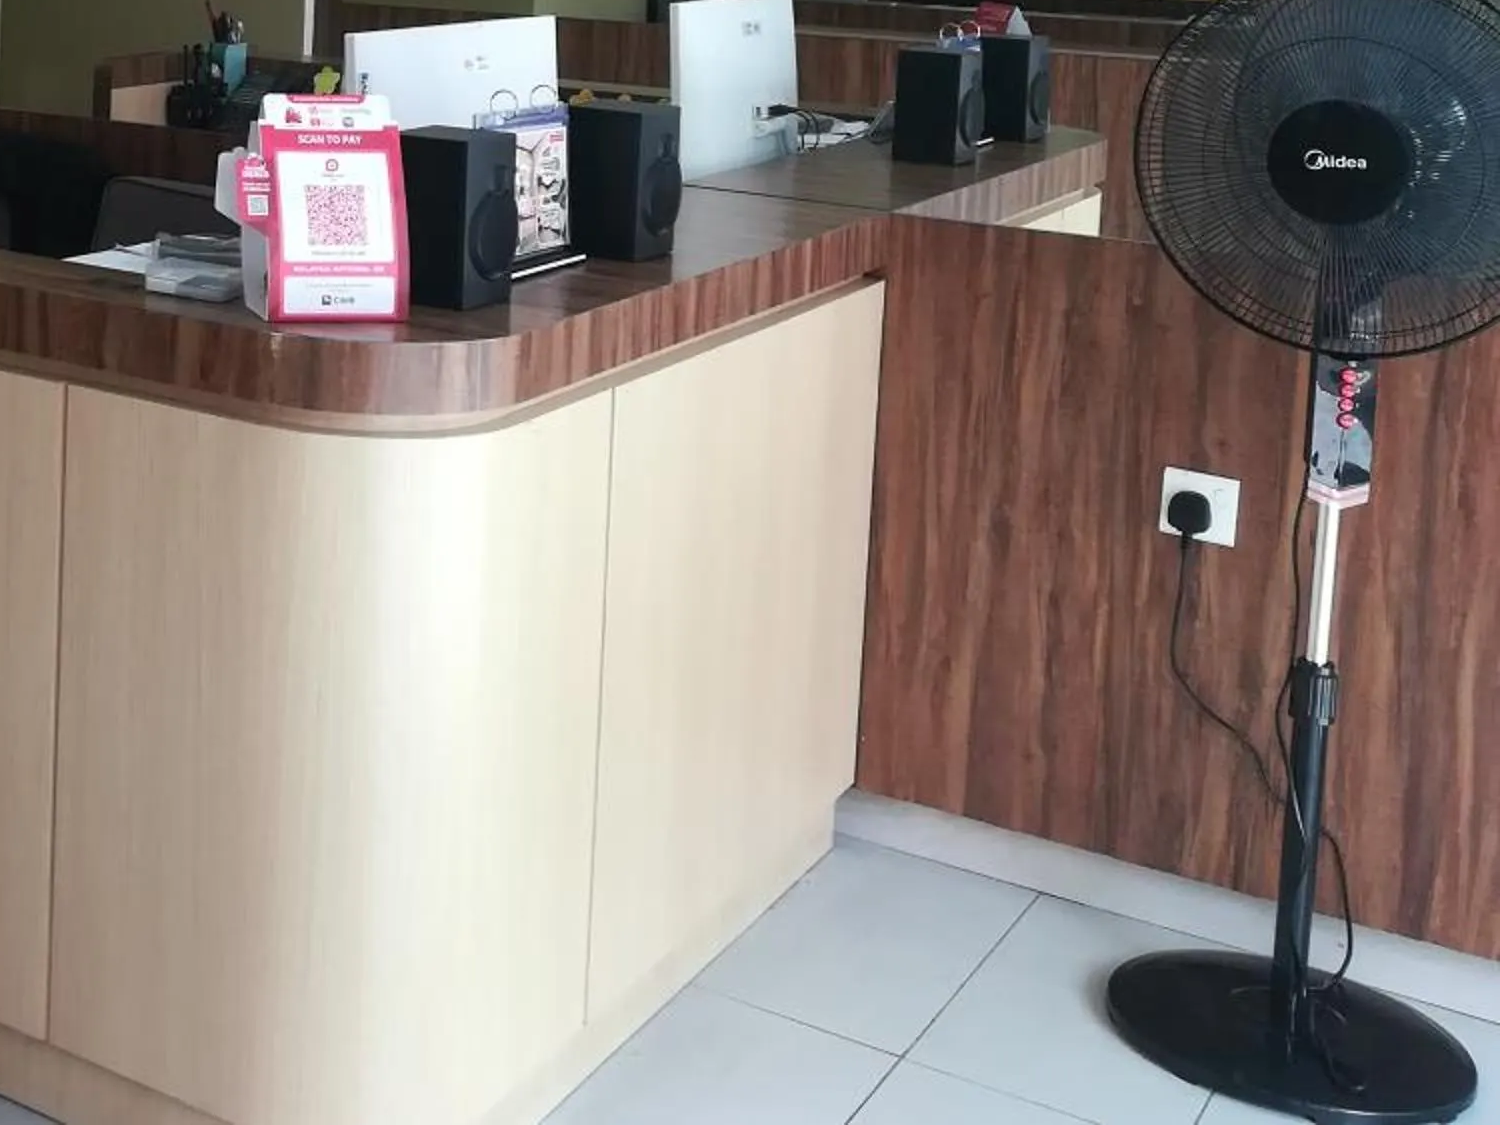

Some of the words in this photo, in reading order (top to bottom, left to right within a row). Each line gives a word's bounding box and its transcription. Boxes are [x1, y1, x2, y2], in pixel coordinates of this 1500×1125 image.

[297, 133, 325, 145] SCAN
[326, 134, 341, 145] TO
[342, 134, 362, 145] PAY
[1304, 148, 1368, 169] Midea
